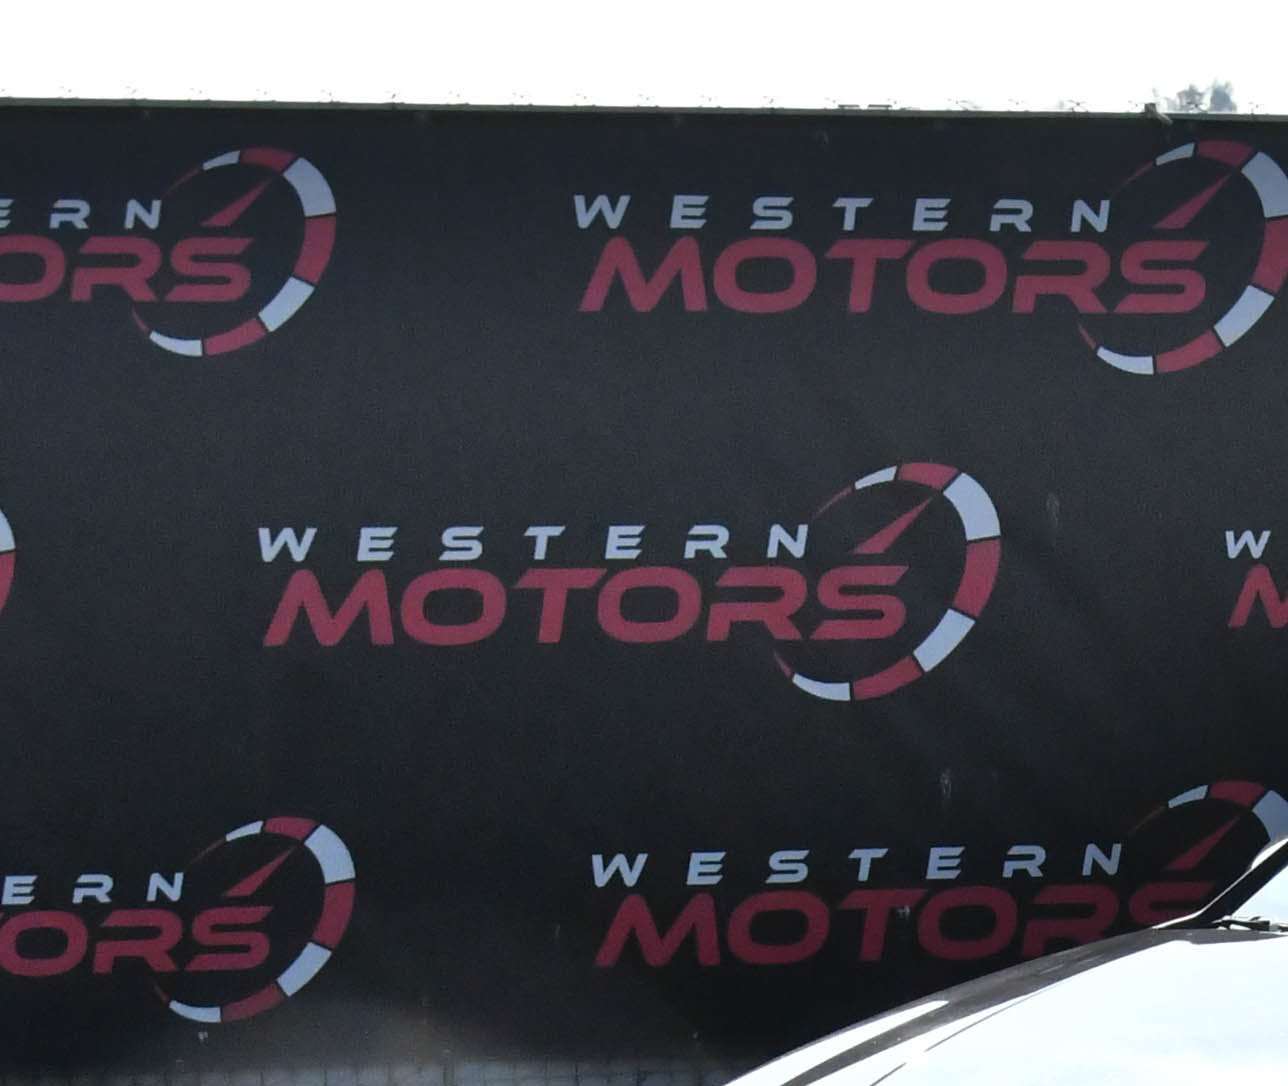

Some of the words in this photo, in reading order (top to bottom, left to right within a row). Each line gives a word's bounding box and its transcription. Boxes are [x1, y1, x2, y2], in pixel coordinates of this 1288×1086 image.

[573, 195, 1110, 232] WESTERN
[579, 236, 1208, 314] MOTORS
[258, 525, 809, 563] WESTERN
[263, 565, 909, 647] MOTORS
[591, 843, 1122, 888] WESTERN
